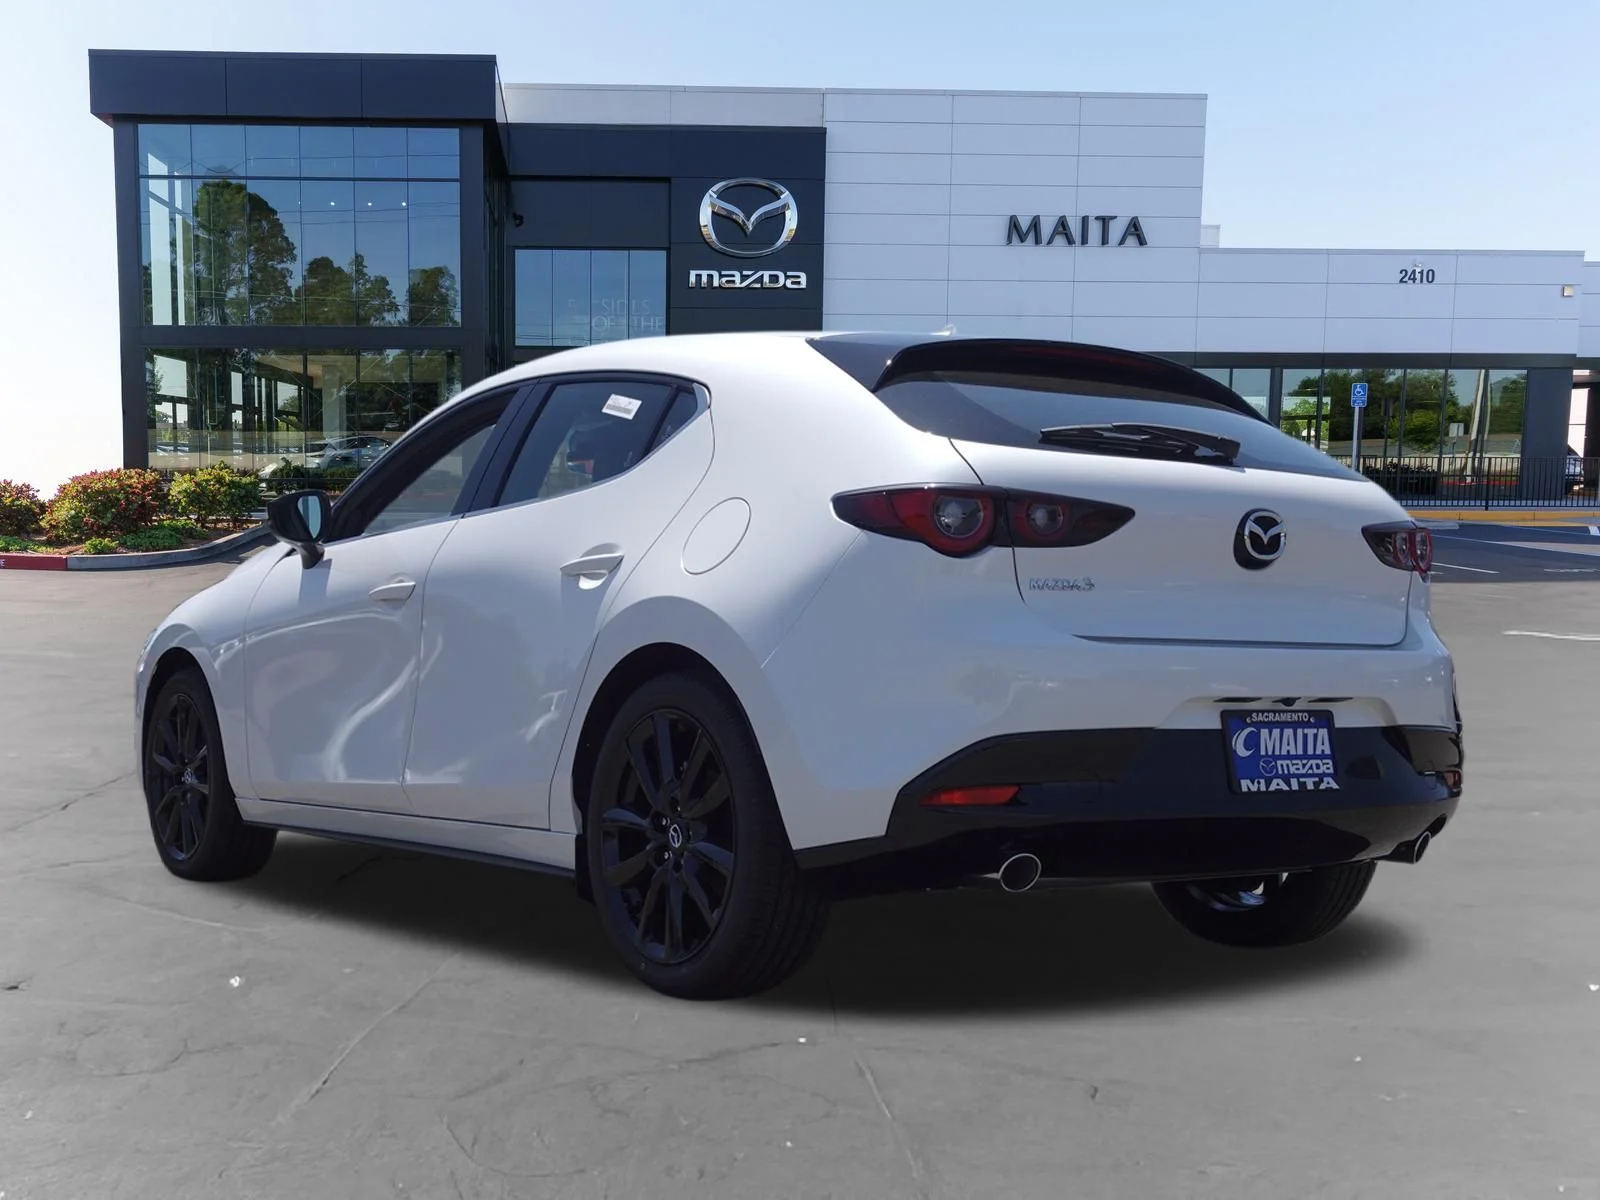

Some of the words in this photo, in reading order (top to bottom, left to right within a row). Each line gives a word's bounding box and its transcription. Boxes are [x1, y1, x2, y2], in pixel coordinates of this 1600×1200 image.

[1006, 214, 1148, 246] MAITA
[1399, 268, 1435, 284] 2410
[1251, 712, 1309, 722] SACRAMENTO
[1260, 727, 1331, 756] MAITA
[1240, 777, 1340, 792] MAITA
